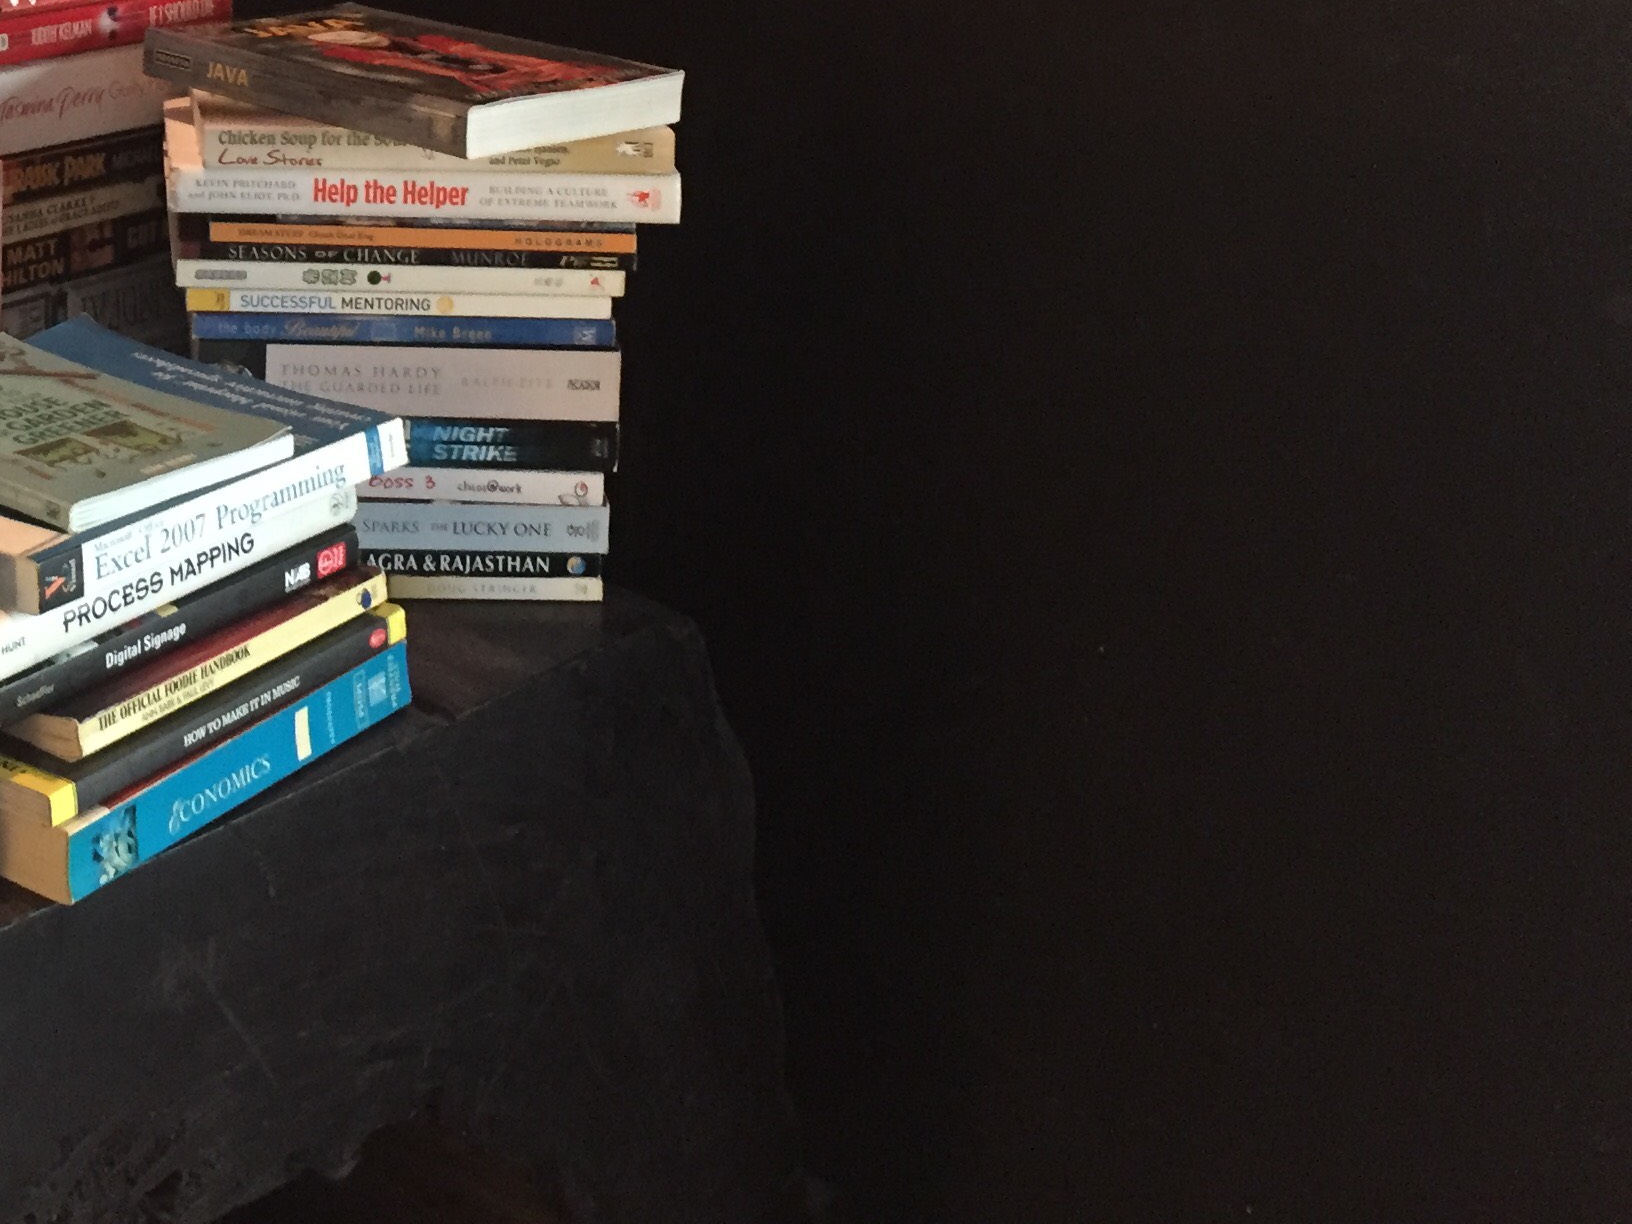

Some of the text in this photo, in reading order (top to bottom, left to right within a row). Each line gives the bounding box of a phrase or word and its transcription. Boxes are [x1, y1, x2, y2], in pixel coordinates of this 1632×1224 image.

[207, 60, 249, 88] JAVA
[217, 128, 371, 150] Chicken Soup for the
[217, 147, 259, 167] Love
[312, 177, 470, 210] Help the Helper
[6, 238, 58, 265] MATT
[514, 236, 604, 249] HOLOGRAMS
[227, 244, 308, 261] SEASONS
[342, 246, 419, 265] CHANGE
[239, 294, 432, 312] SUCCESSFUL MENTORING
[280, 363, 442, 378] THOMAS HARDY
[319, 382, 401, 395] GUARDED
[407, 383, 441, 396] LIFE
[432, 426, 511, 444] NIGHT
[431, 443, 518, 463] STRIKE
[424, 475, 436, 490] 3
[95, 533, 153, 581] Excel
[160, 513, 207, 555] 2007
[215, 463, 347, 530] Programming
[362, 519, 552, 537] SPARKS LUCKY ONE
[366, 552, 551, 574] AGRA & RAJASTHAN
[62, 575, 165, 634] PROCESS
[169, 532, 256, 587] MAPPING
[0, 636, 28, 656] HUNT
[104, 621, 189, 669] Digital Signage
[98, 644, 252, 732] THE OFFICIAL FOODIE HANDBOOK
[183, 674, 301, 748] HOW TO MAKE IT IN MUSIC
[168, 753, 272, 836] ECONOMICS
